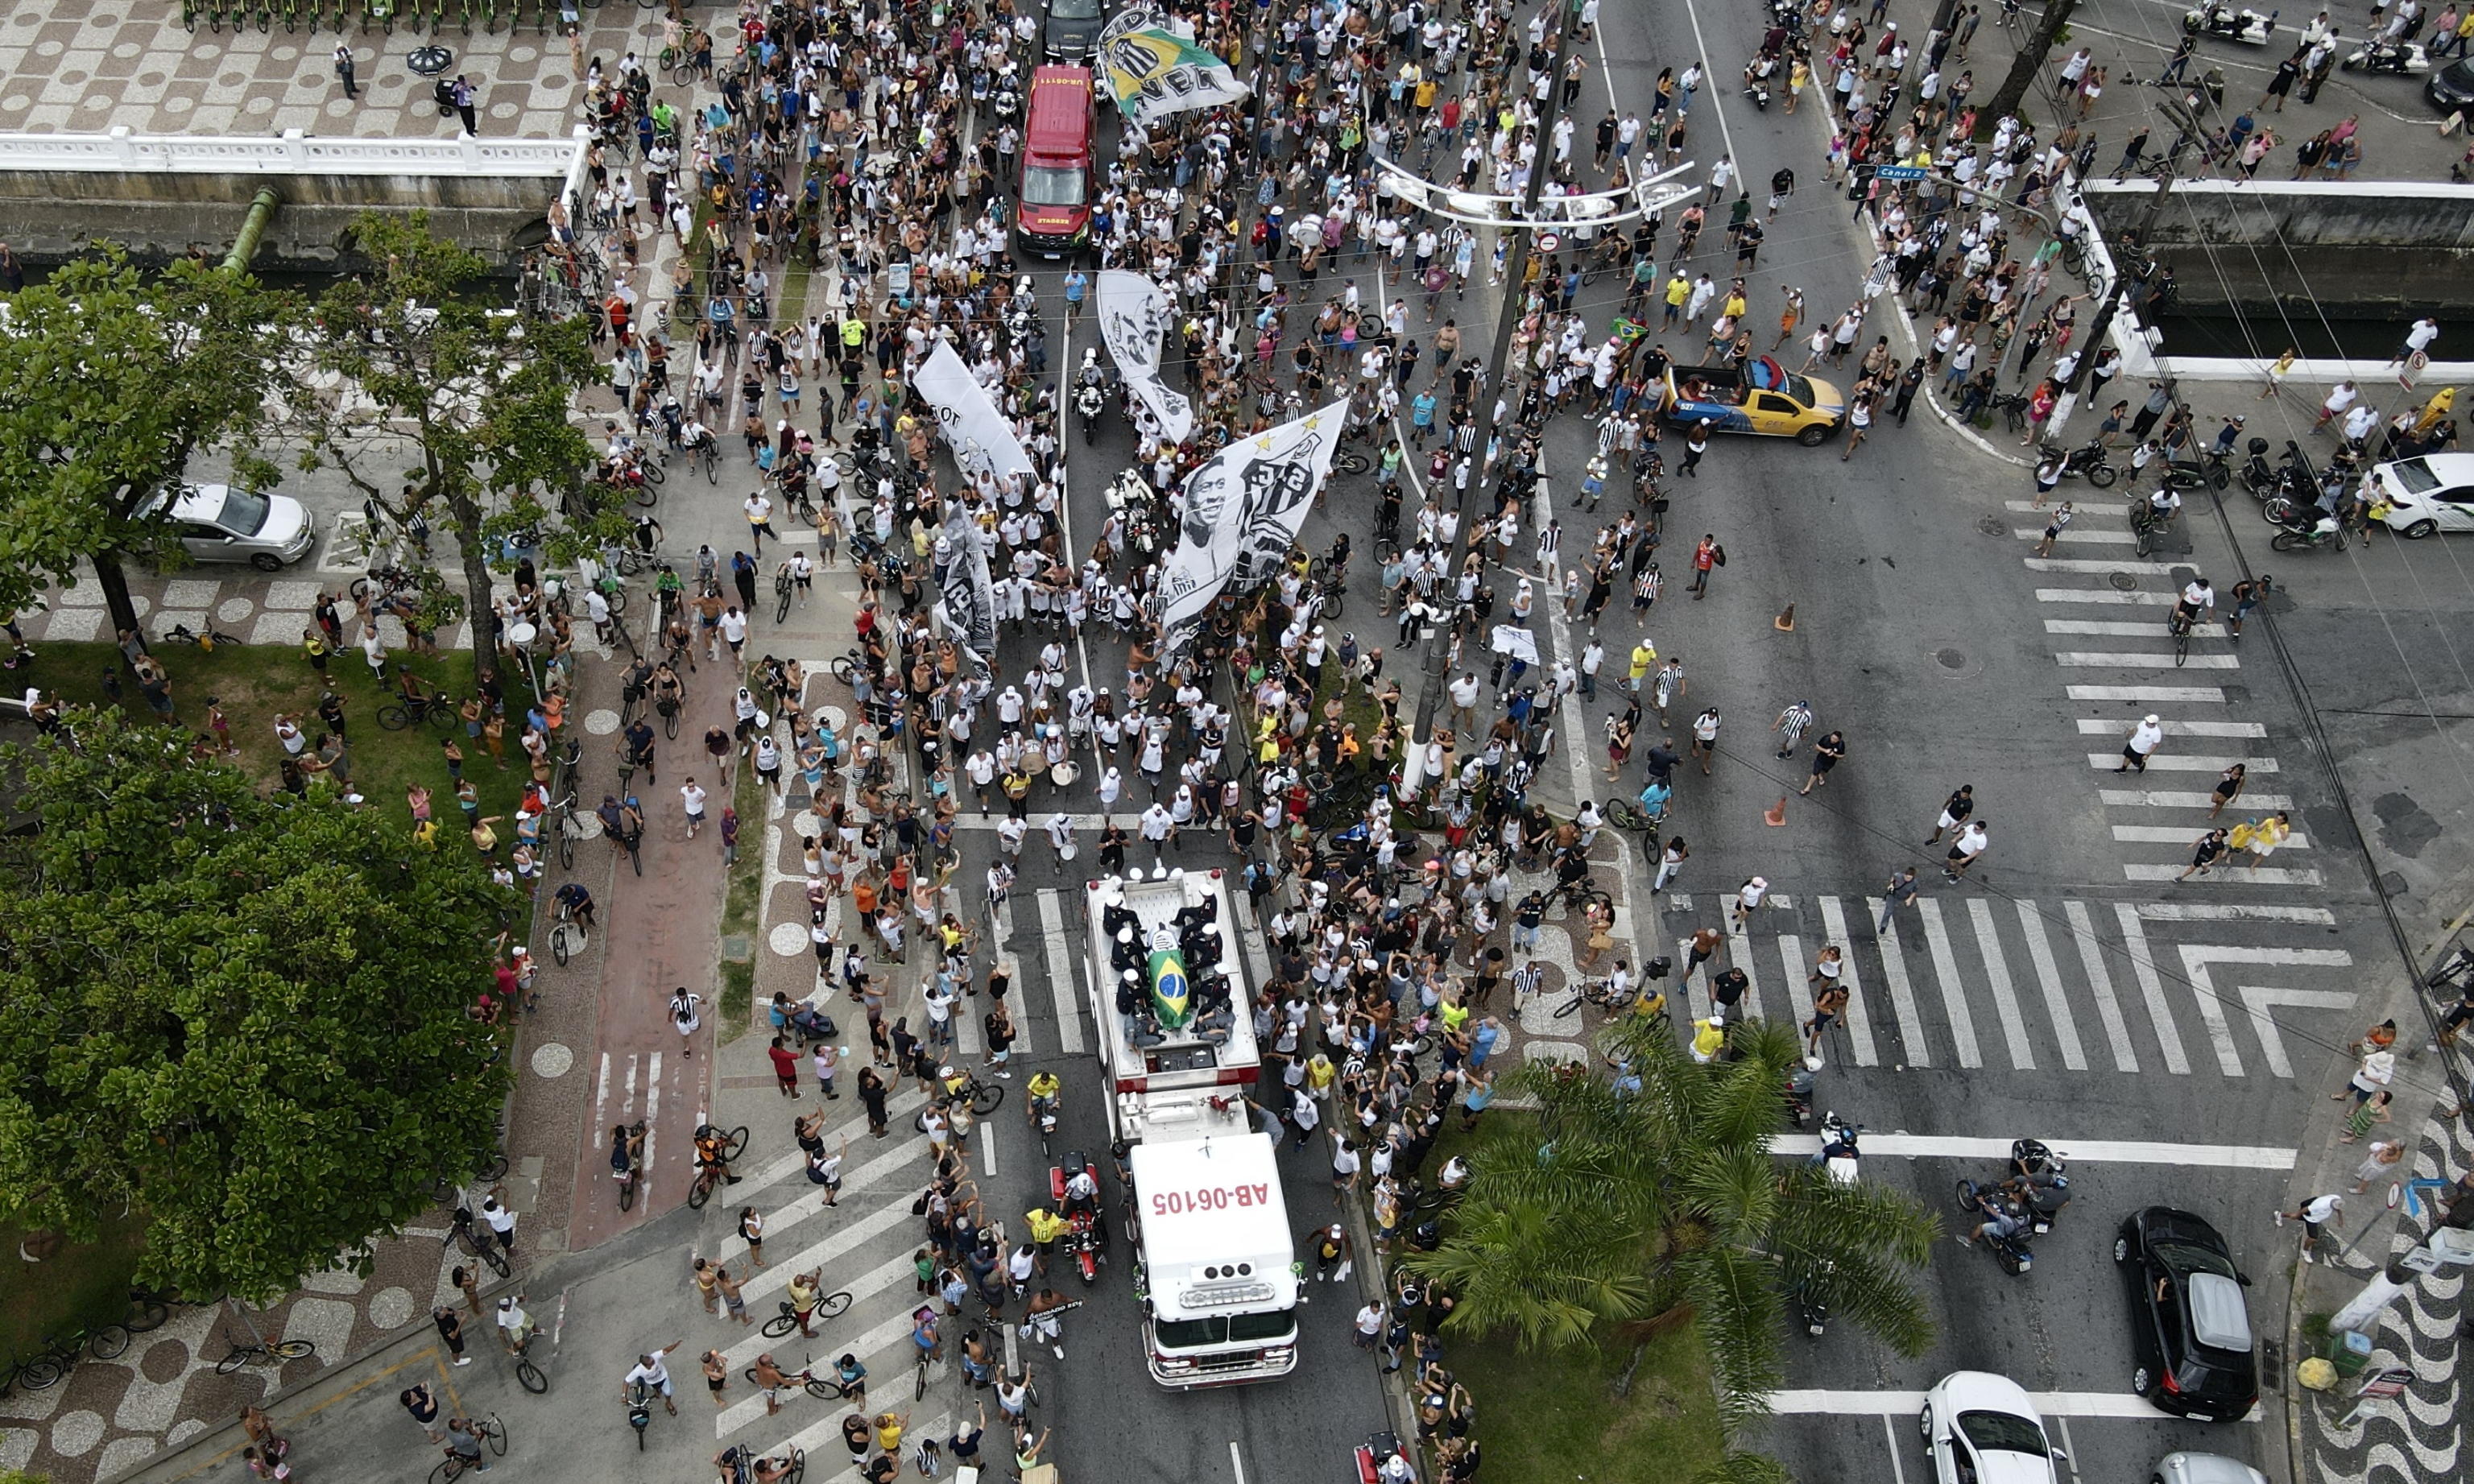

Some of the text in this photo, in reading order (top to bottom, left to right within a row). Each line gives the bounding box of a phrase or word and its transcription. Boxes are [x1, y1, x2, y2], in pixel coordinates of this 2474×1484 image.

[1881, 168, 1912, 177] Canal
[1680, 403, 1694, 411] 527
[1152, 1183, 1268, 1215] AB-06105
